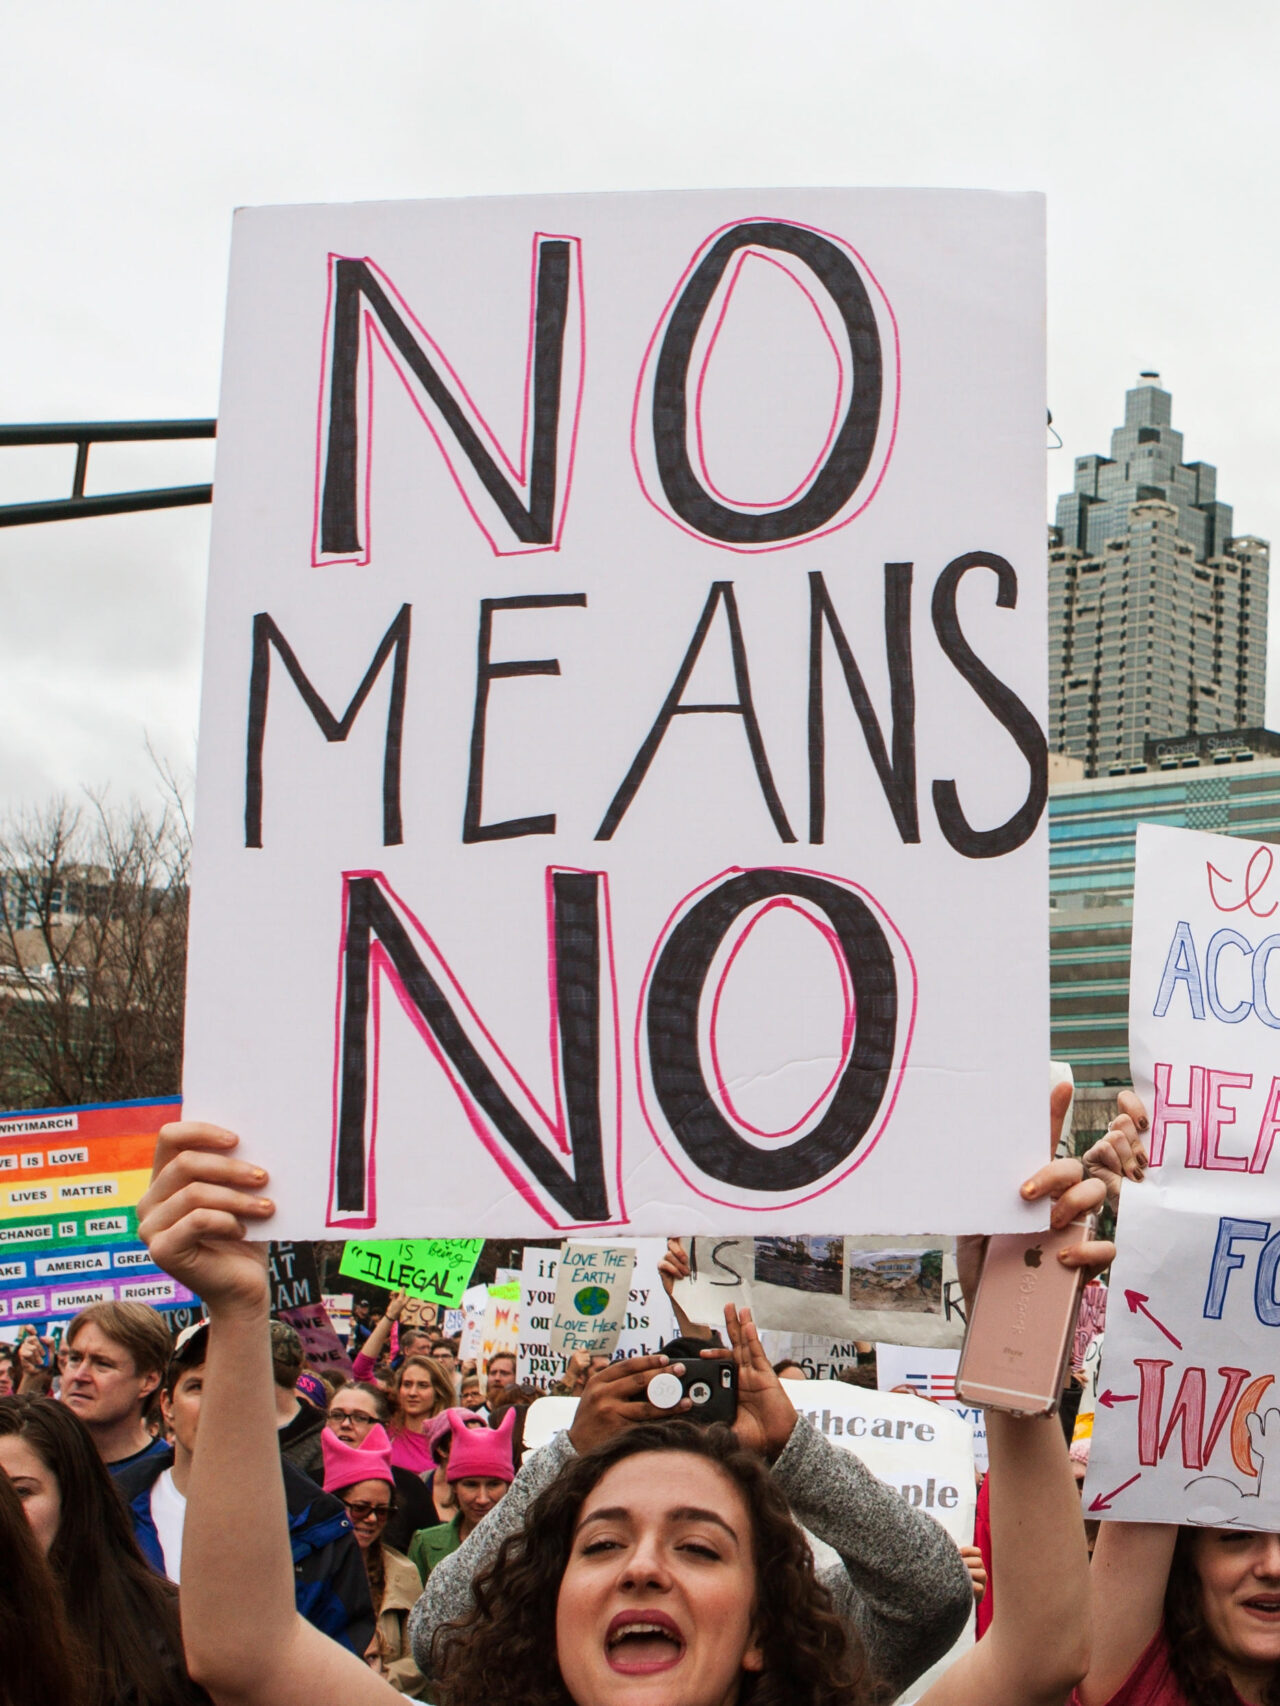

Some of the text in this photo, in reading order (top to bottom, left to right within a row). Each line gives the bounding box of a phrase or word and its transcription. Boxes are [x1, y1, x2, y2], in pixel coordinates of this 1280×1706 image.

[312, 218, 900, 567] NO
[246, 551, 1048, 858] MEANS
[1156, 736, 1244, 757] Coastal States
[1207, 846, 1278, 917] I
[326, 866, 917, 1230] NO
[27, 1157, 39, 1166] IS
[52, 1152, 84, 1164] LOVE
[11, 1185, 112, 1202] LIVES MATTER
[0, 1220, 122, 1240] CHANGE IS REAL
[399, 1243, 415, 1261] IS
[563, 1247, 598, 1267] LOVE
[603, 1250, 628, 1267] THE
[47, 1259, 103, 1272] AMERICA
[117, 1253, 152, 1265] GREA
[538, 1260, 557, 1278] if
[571, 1268, 616, 1284] EARTH
[16, 1300, 41, 1310] ARE
[57, 1293, 104, 1306] HUMAN
[125, 1286, 172, 1298] RIGHTS
[554, 1313, 618, 1333] LOVE HER
[795, 1408, 935, 1442] thcare
